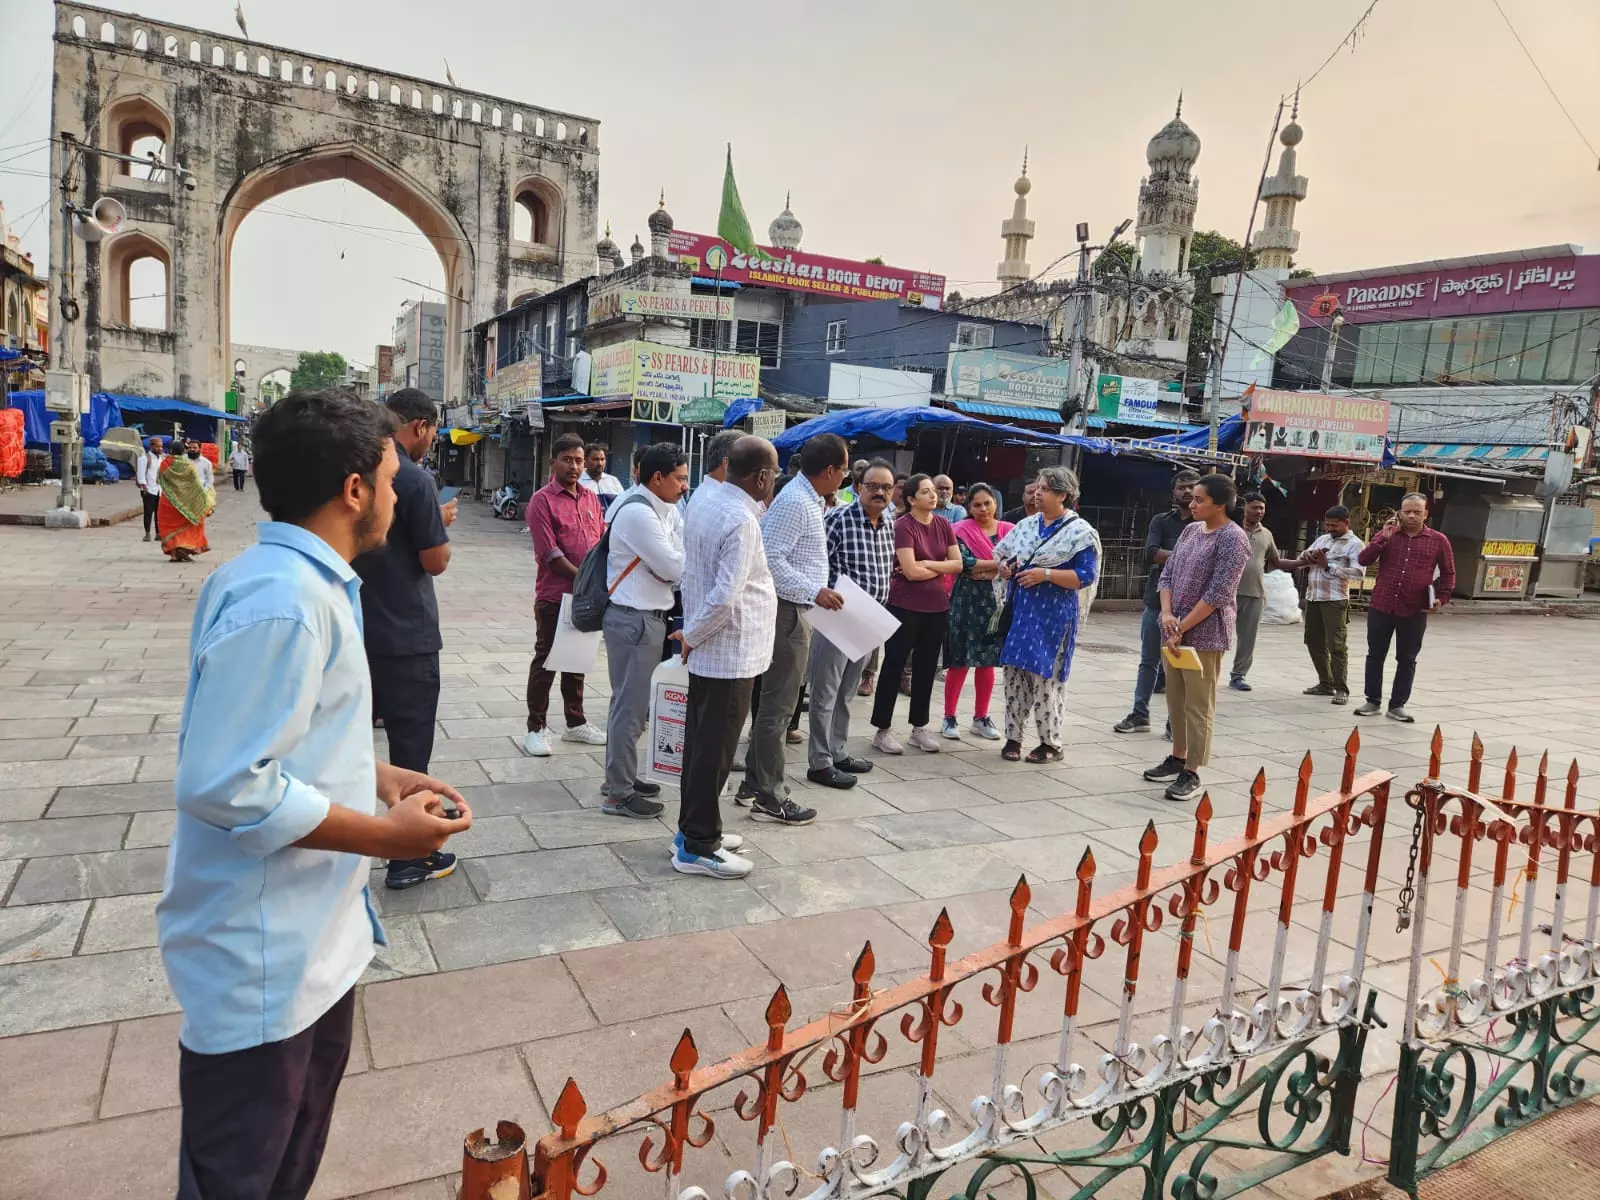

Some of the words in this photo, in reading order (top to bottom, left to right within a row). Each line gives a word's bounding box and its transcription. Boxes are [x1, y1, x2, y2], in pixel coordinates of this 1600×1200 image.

[731, 248, 823, 280] Zeeshan
[827, 268, 860, 286] BOOK
[866, 275, 905, 292] DEPOT
[749, 270, 785, 284] ISLAMIC
[787, 278, 810, 288] BOOK
[812, 281, 841, 292] SELLER
[844, 286, 850, 294] &
[1347, 282, 1426, 305] PARADISE
[638, 295, 648, 308] SS
[650, 296, 680, 311] PEARLS
[682, 299, 687, 311] &
[429, 329, 442, 389] TRENDS
[651, 352, 663, 368] SS
[665, 353, 700, 373] PEARLS
[701, 357, 708, 375] &
[1009, 382, 1034, 393] BOOK
[1037, 385, 1065, 396] DEPOT
[1125, 398, 1158, 409] FAMOUS
[1257, 394, 1331, 417] CHARMINAR
[1335, 400, 1385, 421] BANGLES
[1285, 416, 1310, 427] PEARLS
[1319, 420, 1355, 431] JEWELLERY
[1483, 541, 1500, 555] FAST
[1500, 542, 1514, 555] FOOD
